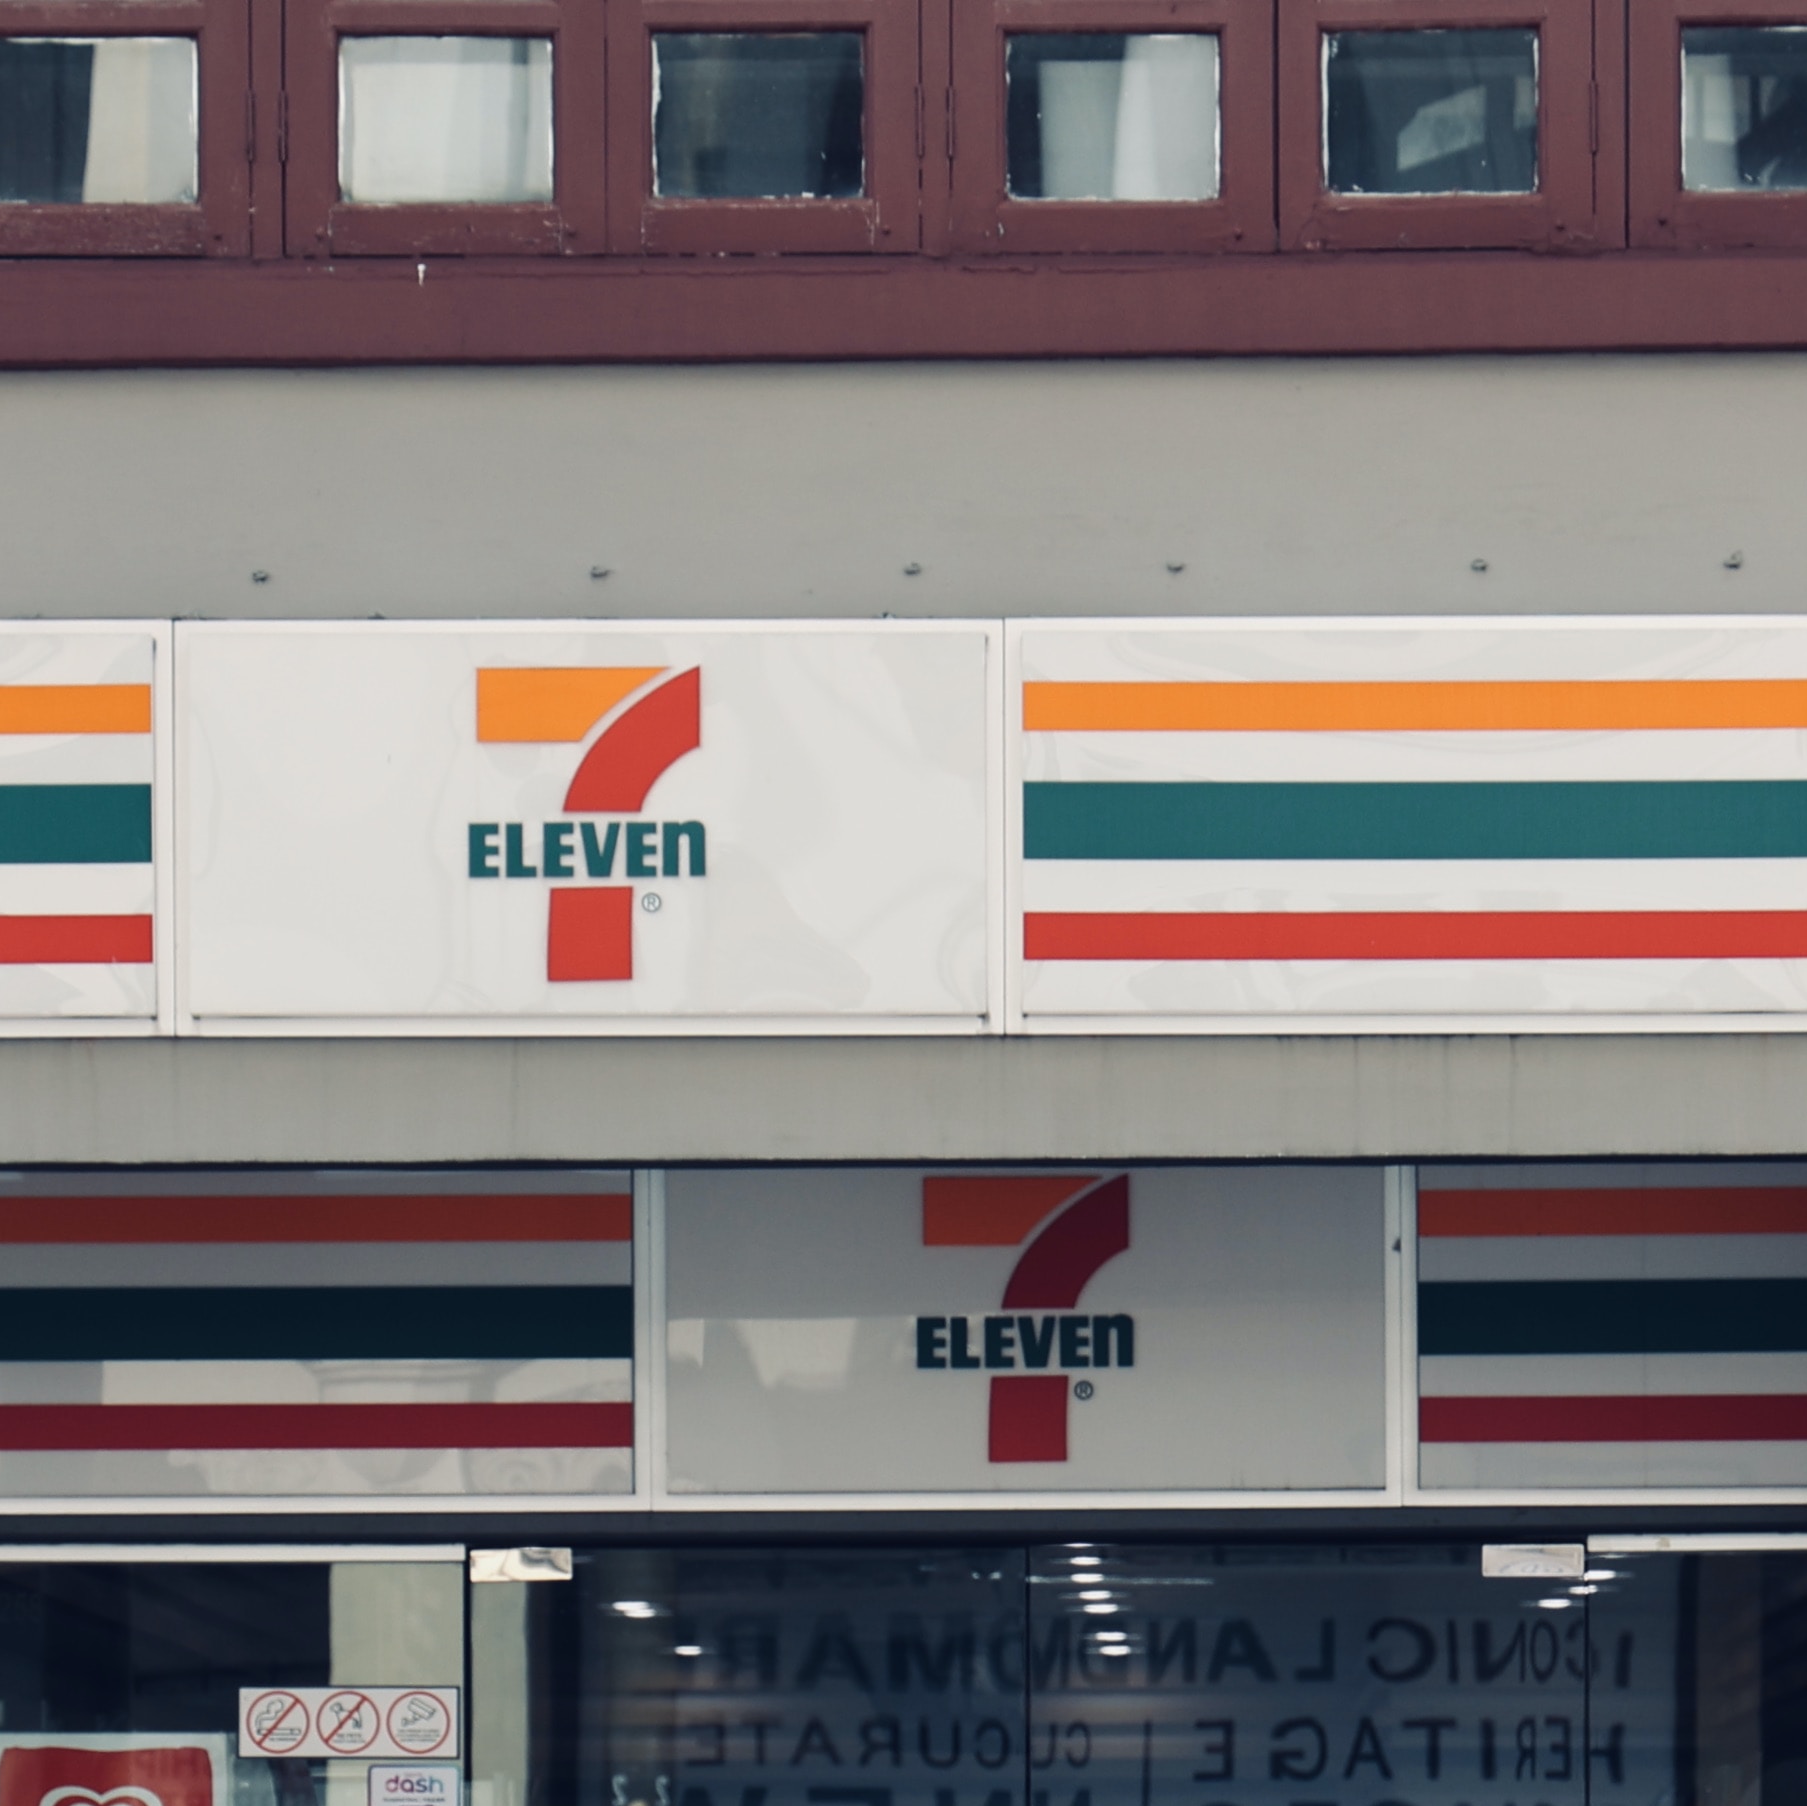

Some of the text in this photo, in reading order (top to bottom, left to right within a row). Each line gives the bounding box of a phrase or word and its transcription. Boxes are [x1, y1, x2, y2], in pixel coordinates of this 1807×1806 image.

[476, 664, 701, 982] 7
[922, 1172, 1130, 1463] 7
[385, 1775, 444, 1794] dash
